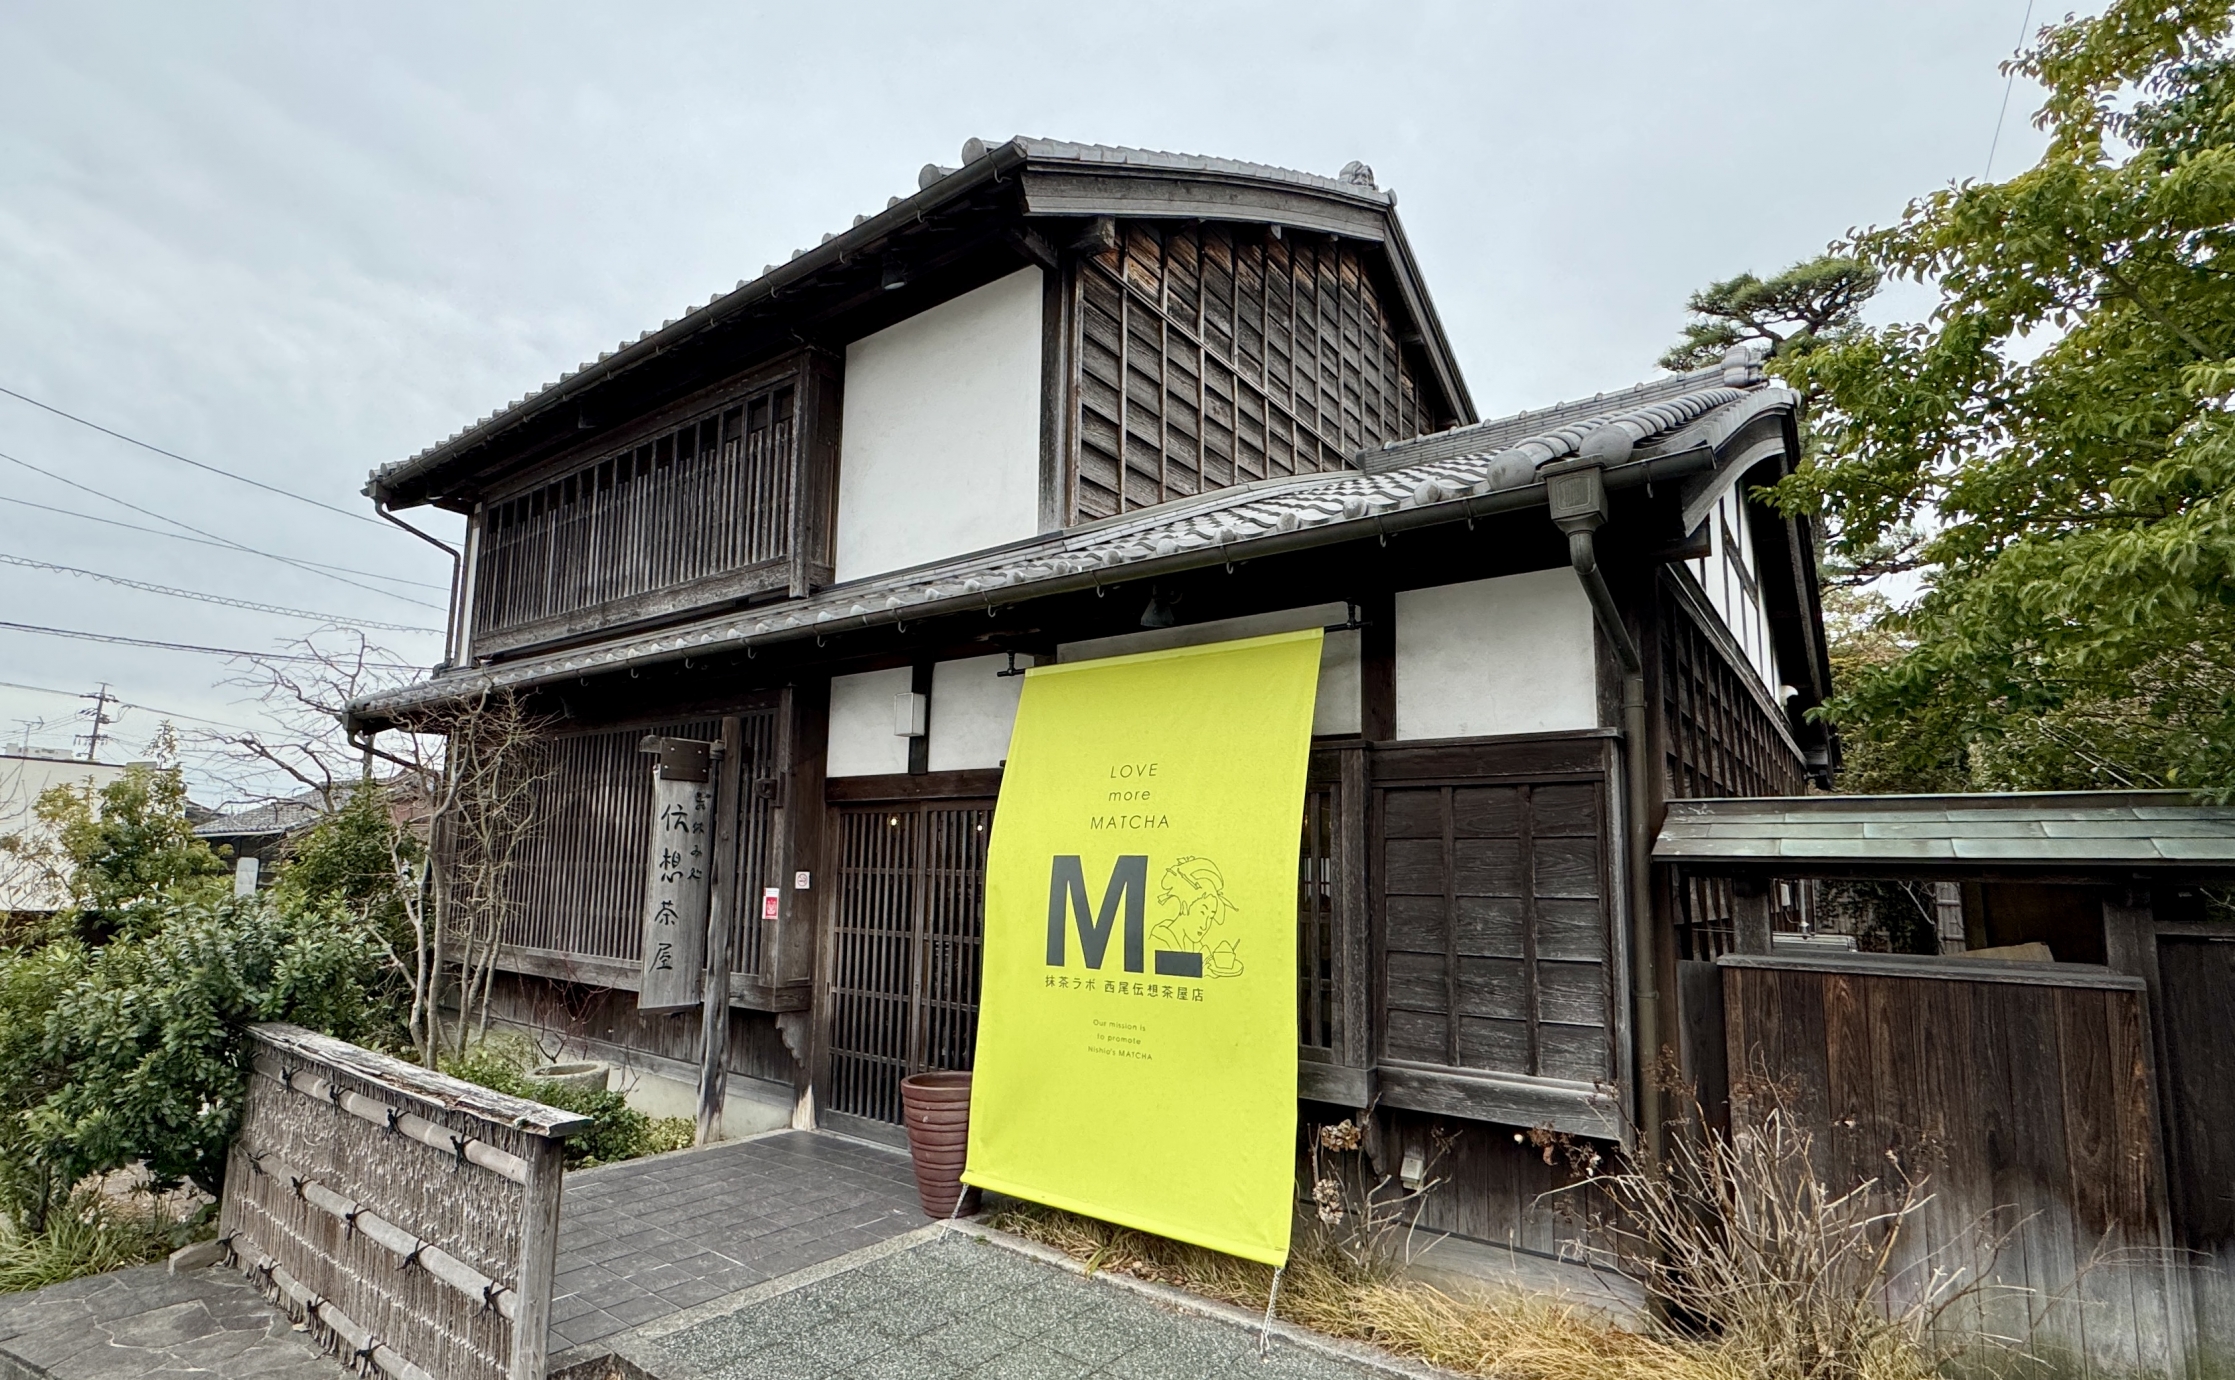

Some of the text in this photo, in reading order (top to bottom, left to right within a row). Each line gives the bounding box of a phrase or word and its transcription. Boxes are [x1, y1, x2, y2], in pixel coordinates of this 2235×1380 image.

[1110, 763, 1158, 779] LOVE
[1108, 788, 1151, 802] more
[1090, 814, 1170, 830] MATCHA
[649, 803, 690, 971] 伝想茶屋
[1104, 980, 1204, 1002] 西尾伝想茶屋店
[1092, 1018, 1146, 1032] Our mission is
[1107, 1035, 1142, 1045] promote
[1087, 1045, 1153, 1061] Nishio's MATCHA
